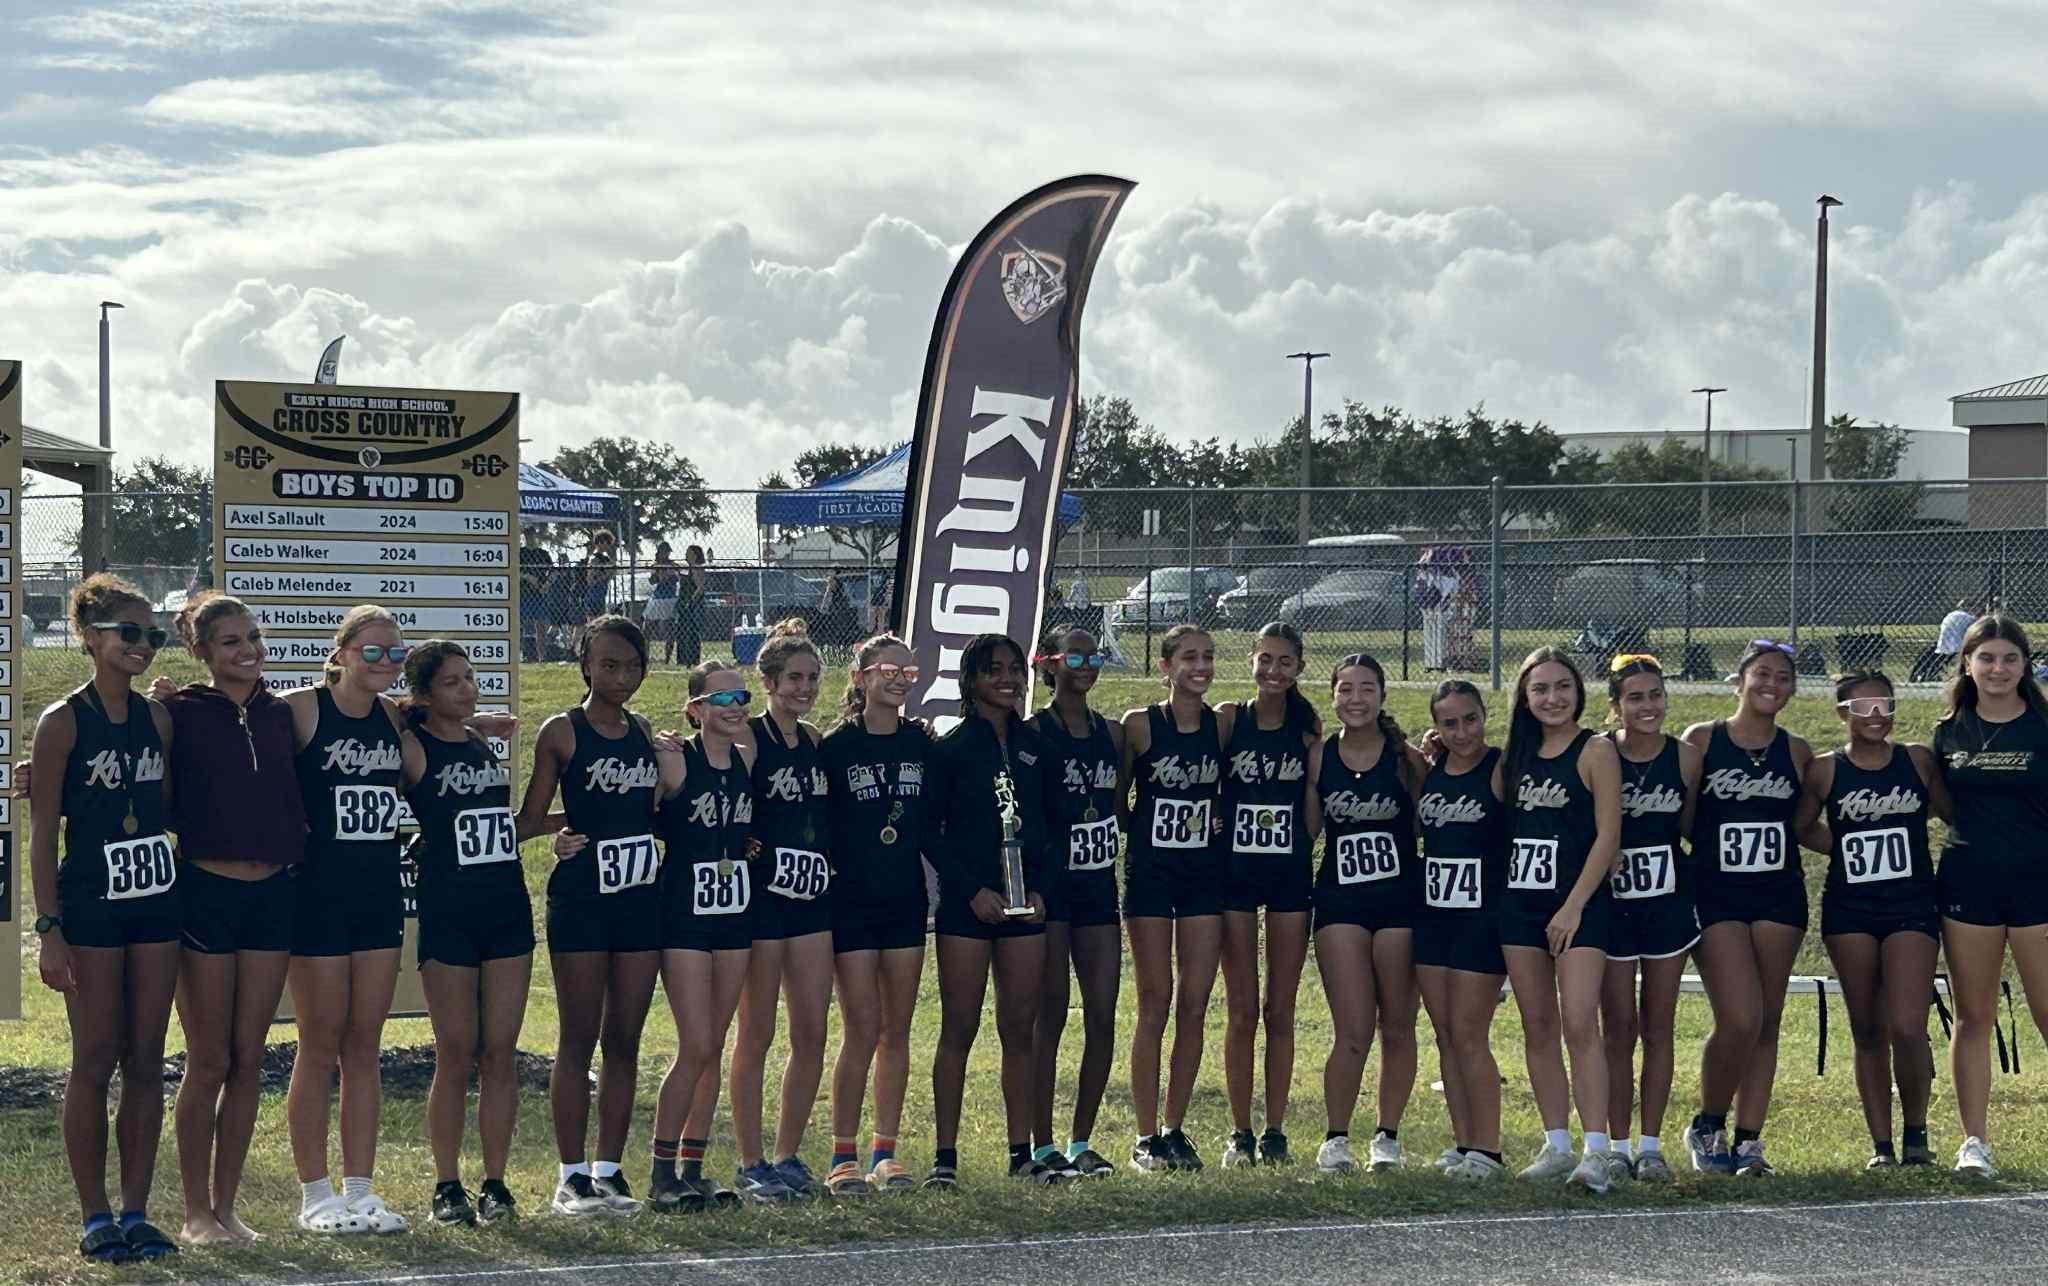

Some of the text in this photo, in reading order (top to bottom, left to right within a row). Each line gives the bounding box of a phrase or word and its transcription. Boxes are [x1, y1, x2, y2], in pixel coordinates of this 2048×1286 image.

[291, 394, 449, 412] EAST RIDGE HIGH SCHOOL
[273, 409, 466, 438] CROSS COUNTRY
[281, 473, 455, 500] BOYS TOP 10
[520, 495, 604, 514] LEGACY CHARTER
[230, 510, 504, 531] Axel Sallault 2024 15:40
[818, 503, 851, 519] FIRST
[231, 543, 504, 563] Caleb Walker 2024 16:04
[231, 576, 504, 595] Caleb Melendez 2021 16:14
[275, 610, 344, 625] Holsbeke
[464, 613, 504, 626] 16:30
[465, 645, 504, 658] 16:38
[321, 738, 402, 777] Knights
[1702, 767, 1794, 800] Knights
[1837, 785, 1922, 822] Knights
[340, 790, 396, 834] 382
[1323, 790, 1401, 824] Knights
[459, 813, 514, 858] 375
[1071, 821, 1119, 865] 385
[1236, 807, 1291, 848] 383
[1724, 826, 1781, 867] 379
[111, 841, 173, 894] 380
[602, 840, 652, 887] 377
[779, 852, 826, 896] 386
[1339, 835, 1396, 878] 368
[1510, 842, 1552, 884] 373
[1613, 850, 1669, 894] 367
[1846, 832, 1908, 877] 370
[697, 865, 745, 909] 381
[1428, 861, 1478, 902] 374
